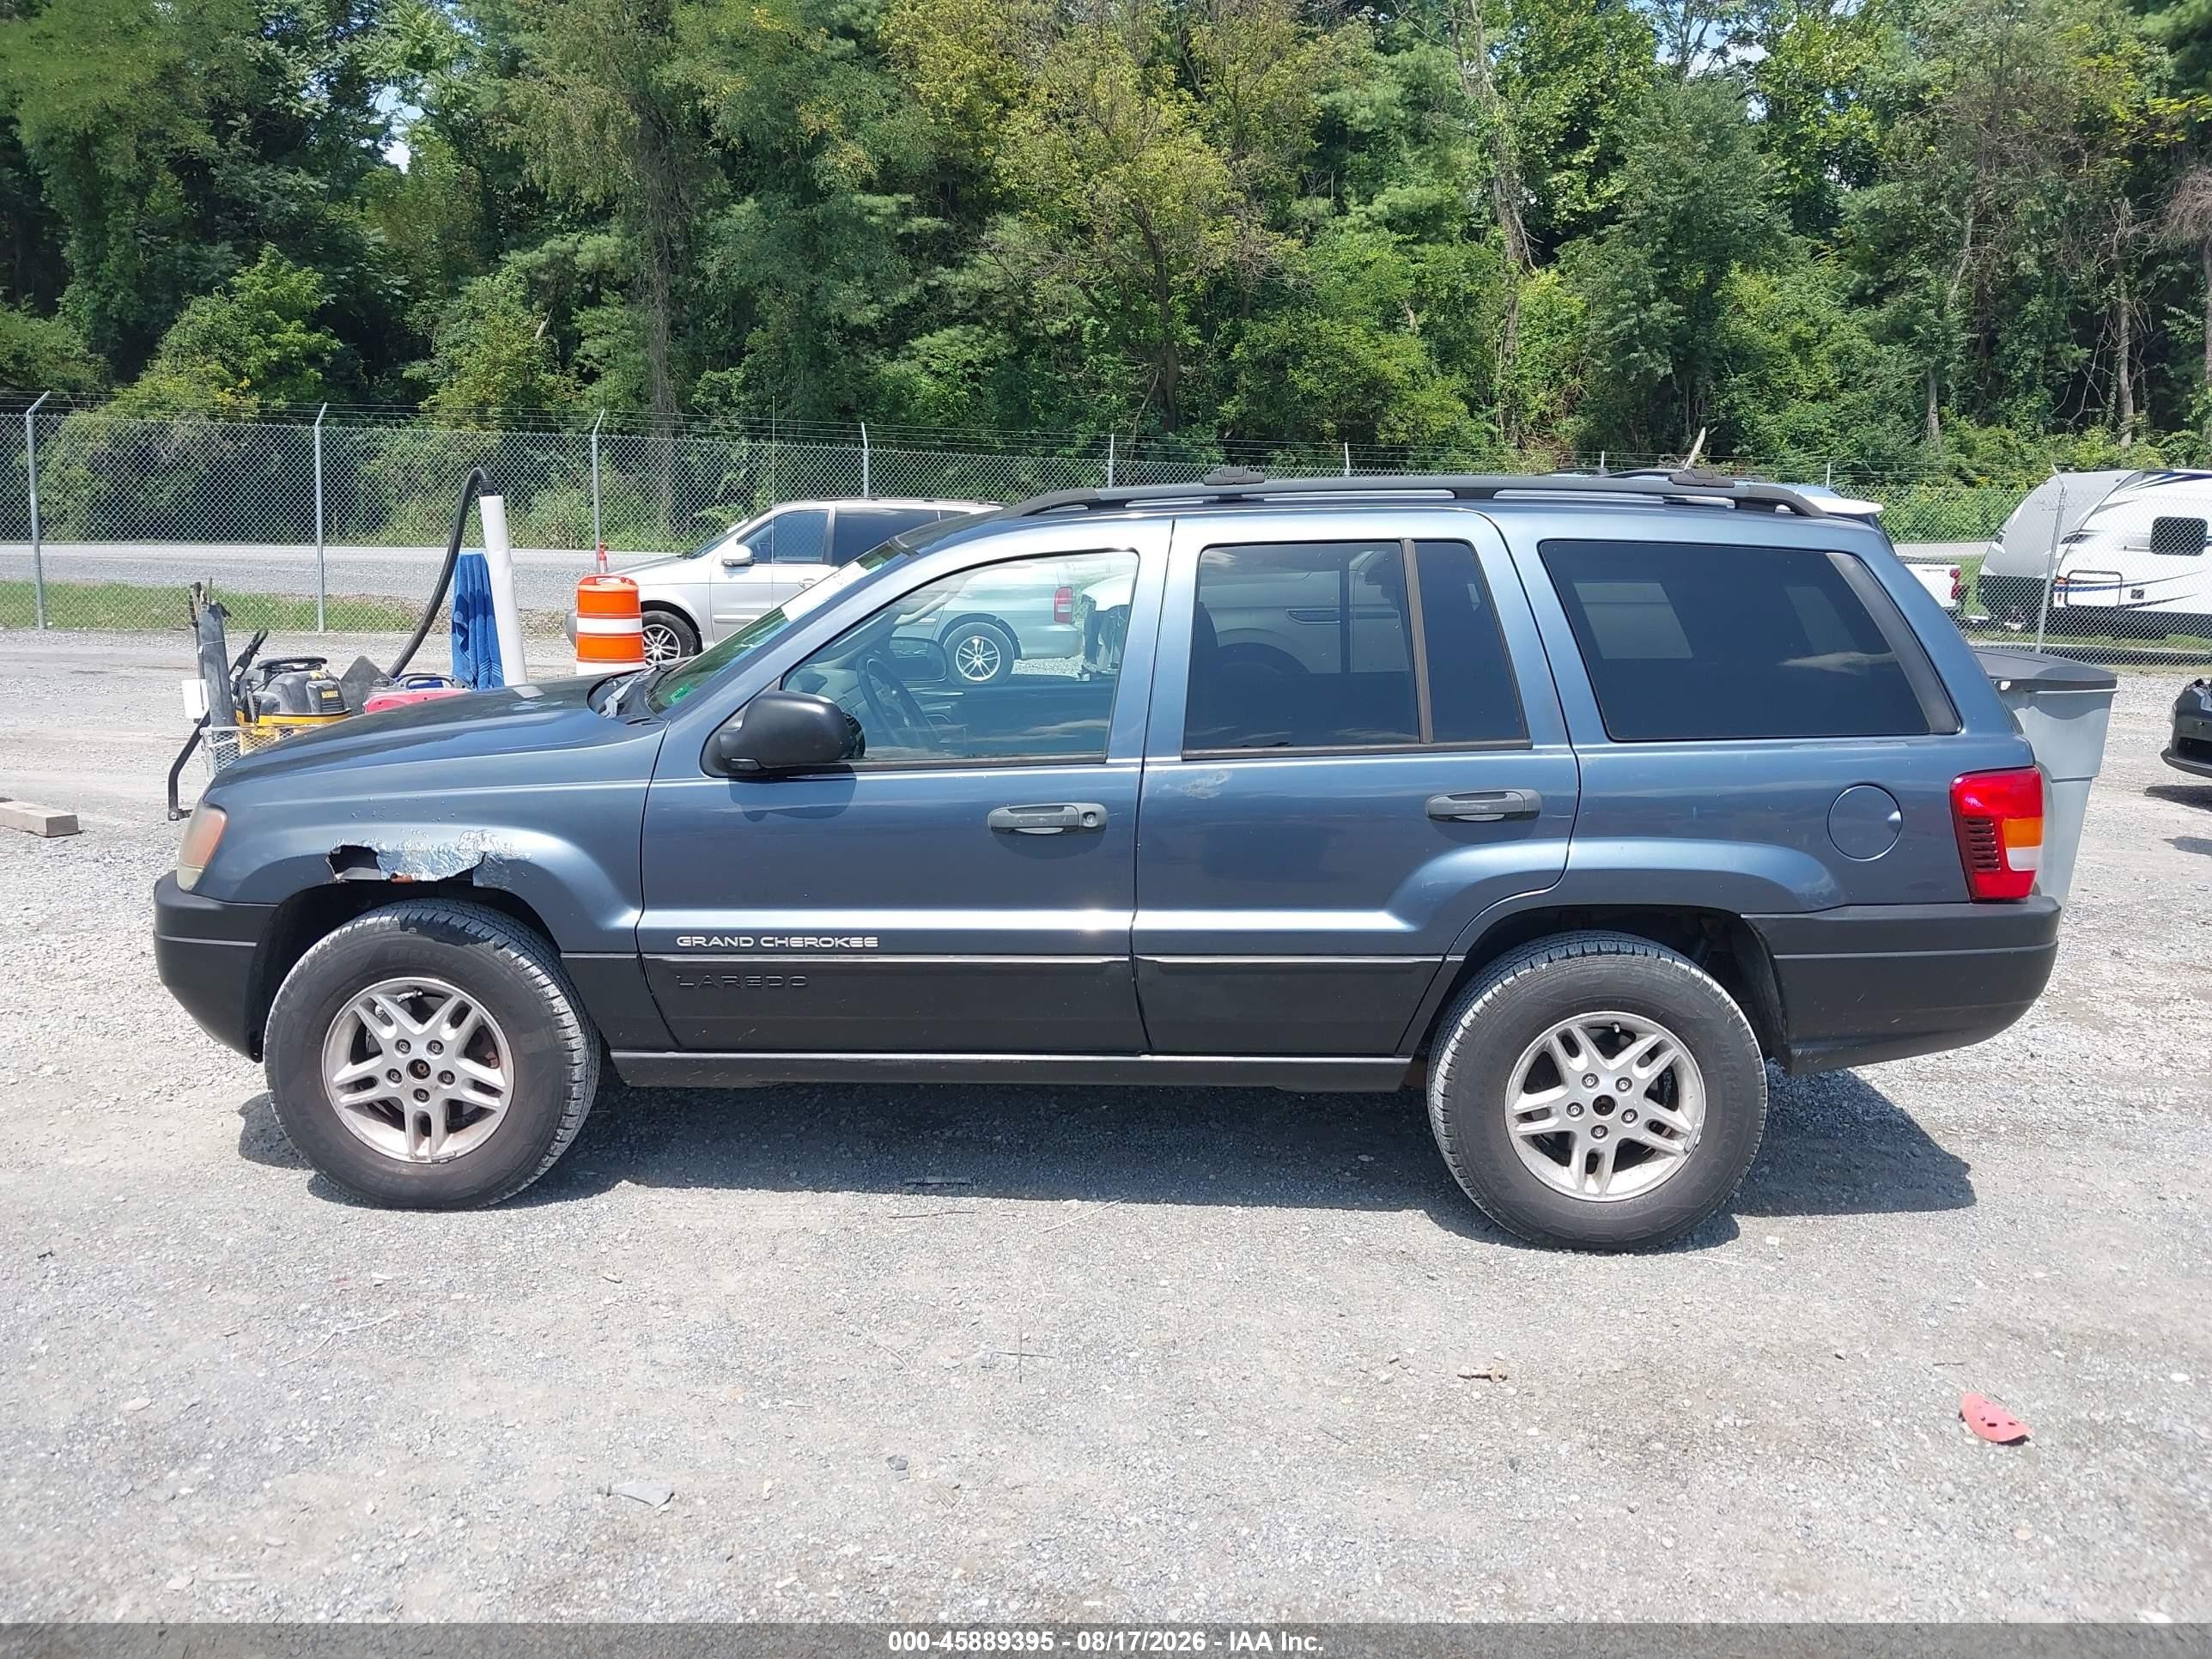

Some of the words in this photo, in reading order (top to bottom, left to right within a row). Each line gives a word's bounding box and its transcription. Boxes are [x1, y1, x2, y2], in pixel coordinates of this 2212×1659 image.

[676, 935, 755, 947] GRAND
[760, 936, 878, 948] CHEROKEE
[676, 975, 810, 988] LAREDO
